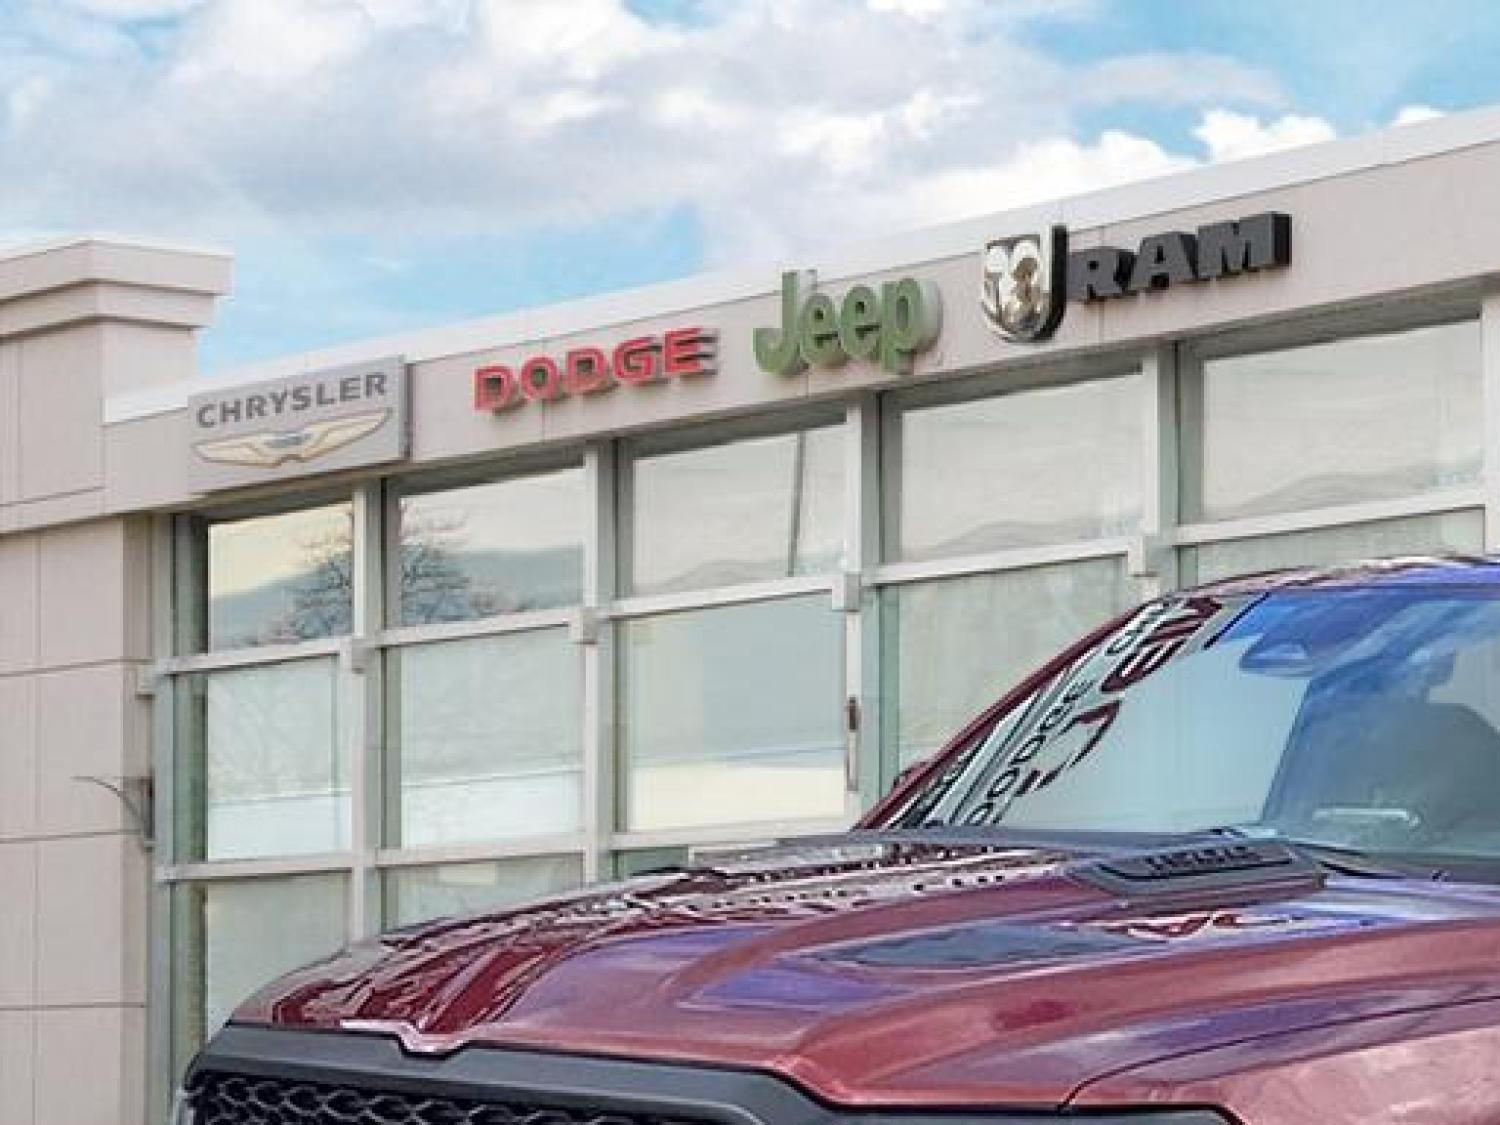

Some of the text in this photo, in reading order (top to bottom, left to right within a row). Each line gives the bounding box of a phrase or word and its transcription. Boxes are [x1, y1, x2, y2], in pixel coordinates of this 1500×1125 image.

[1066, 211, 1292, 301] RAM
[752, 269, 941, 374] Jeep
[196, 371, 387, 428] CHRYSLER
[473, 326, 715, 413] DODGE
